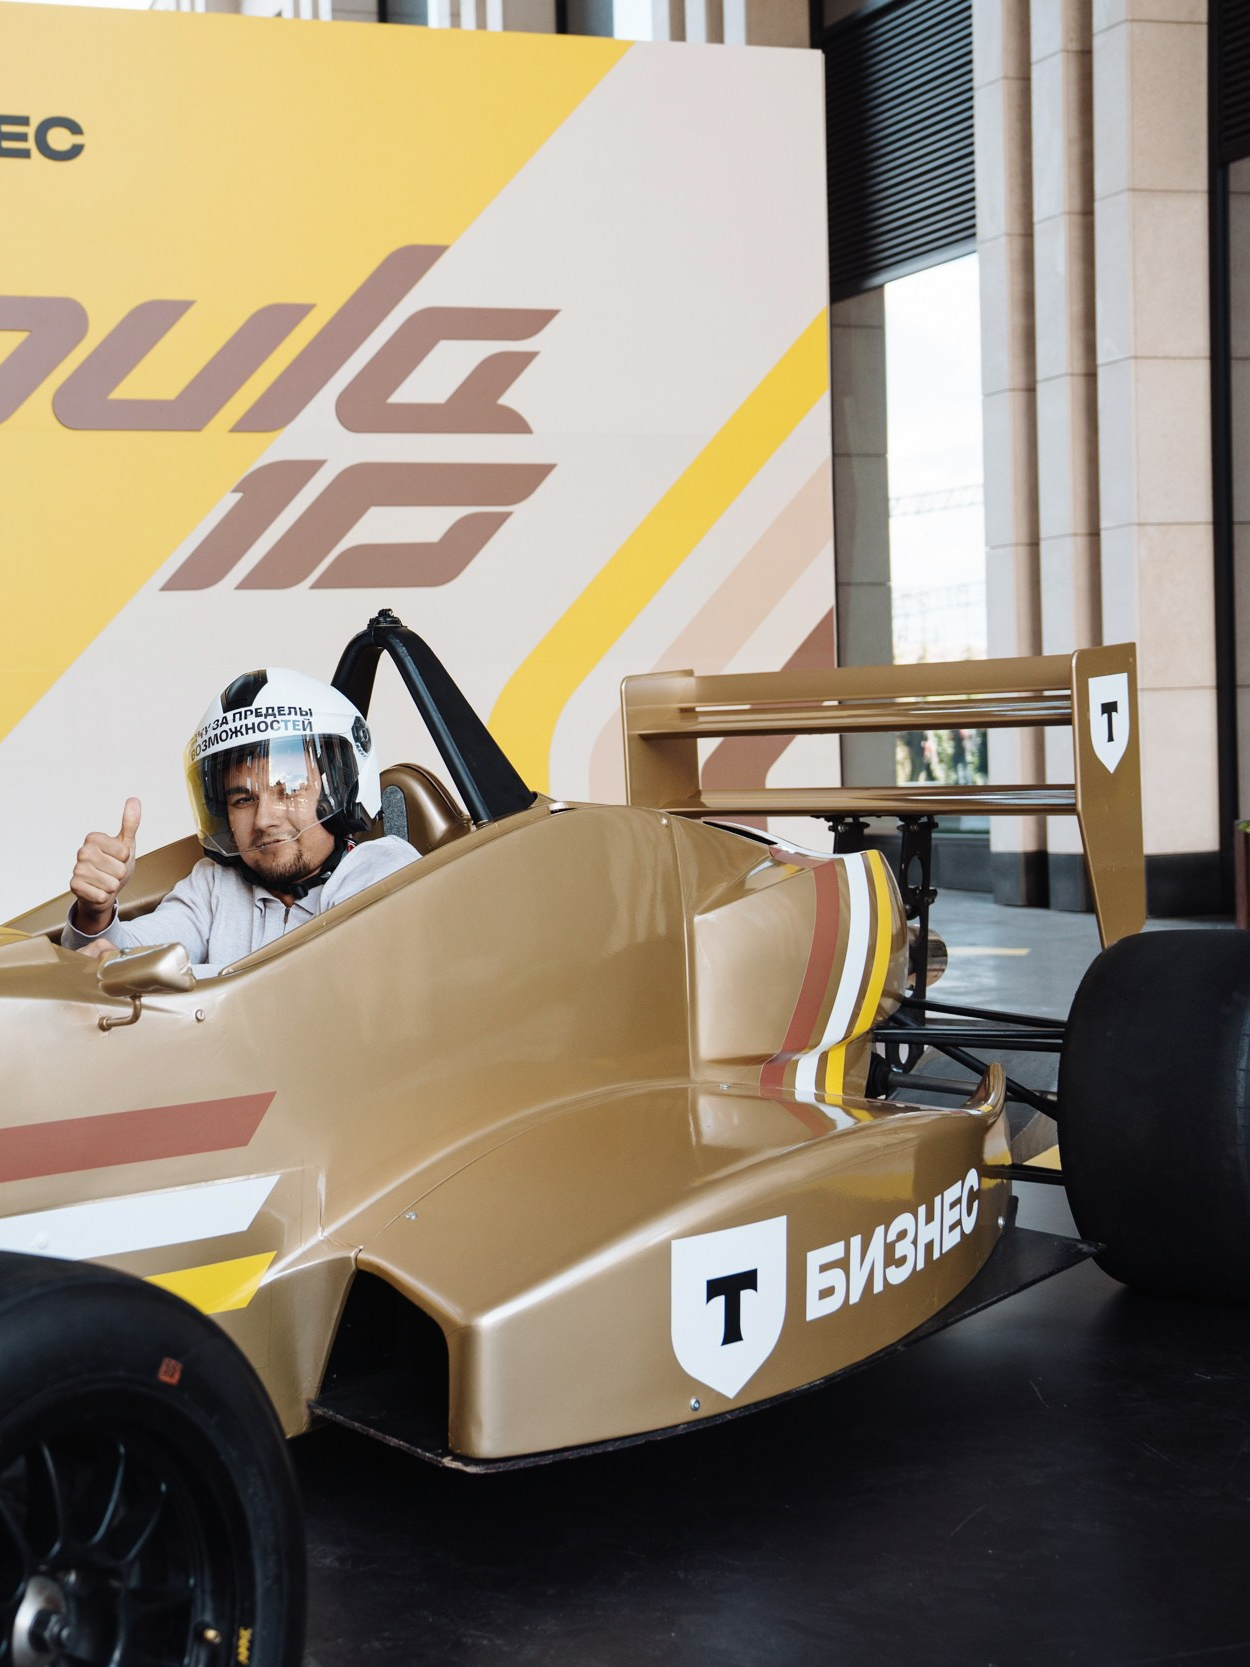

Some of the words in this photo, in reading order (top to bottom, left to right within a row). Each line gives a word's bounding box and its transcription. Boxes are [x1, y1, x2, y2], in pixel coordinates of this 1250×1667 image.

[190, 718, 313, 762] ВОЗМОЖНОСТЕЙ
[212, 715, 229, 731] ЗА
[232, 706, 313, 723] ПРЕДЕЛЫ
[806, 1168, 979, 1322] БИЗНЕС
